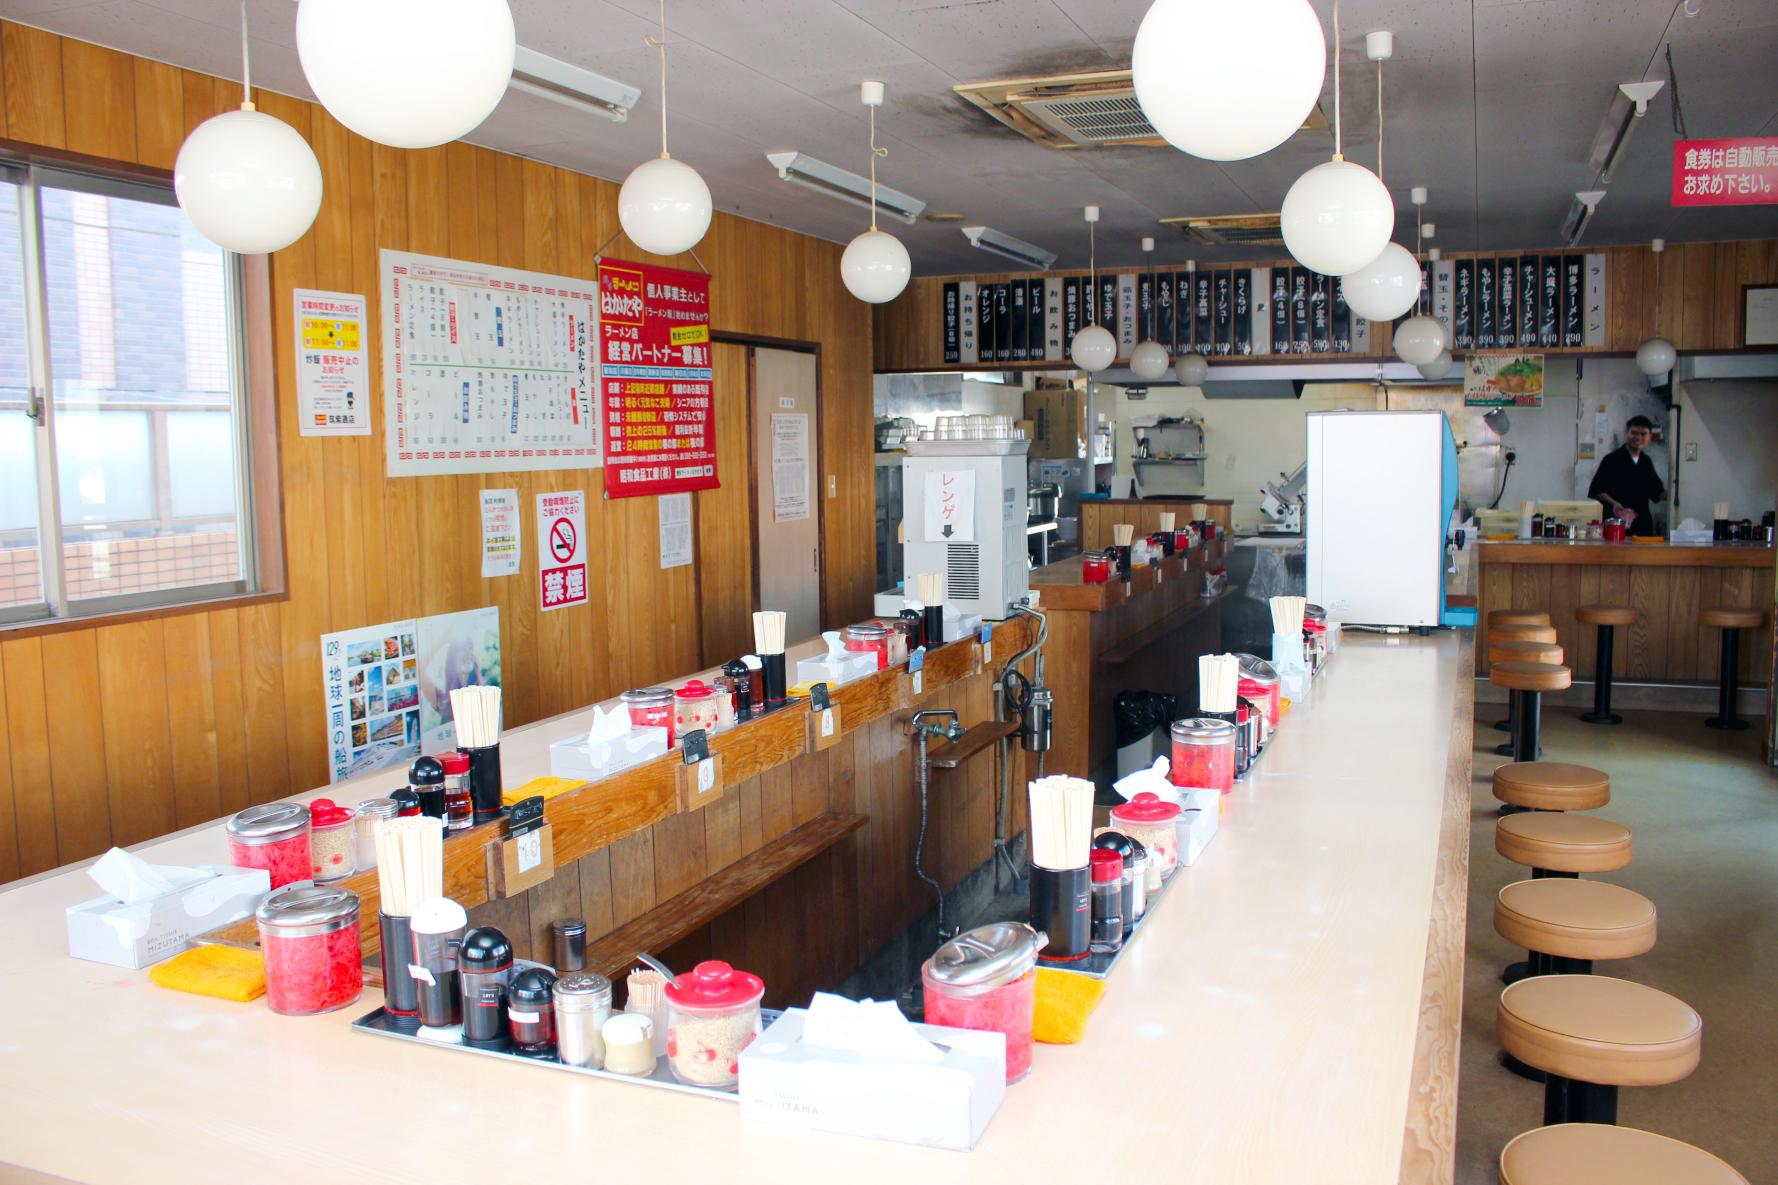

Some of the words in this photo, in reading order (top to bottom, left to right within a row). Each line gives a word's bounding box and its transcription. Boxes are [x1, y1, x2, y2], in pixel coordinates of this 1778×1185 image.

[1684, 146, 1778, 170] 食券は自動販売
[1684, 174, 1770, 195] お求め下さい。
[601, 292, 643, 317] はかたや
[647, 283, 705, 303] 個人事業主として
[999, 289, 1007, 314] コーラ
[1015, 288, 1024, 306] 清酒
[1032, 287, 1041, 314] ビール
[1104, 284, 1113, 320] ゆで玉子
[1161, 281, 1170, 307] もやし
[1180, 280, 1188, 299] ねぎ
[1199, 280, 1208, 317] 辛子高菜
[1219, 279, 1228, 324] チャーシュー
[1238, 278, 1247, 315] きくらげ
[1438, 273, 1449, 328] 替玉・その
[1460, 268, 1470, 325] ネギラーメン
[1482, 267, 1491, 328] もやしラーメン
[1525, 265, 1534, 328] チャーシューメン
[1546, 265, 1556, 327] 大盛ラーメン
[1568, 264, 1579, 327] 博多ラーメン
[1590, 268, 1600, 331] ラーメン
[964, 294, 973, 349] お持ち帰り
[982, 288, 990, 324] オレンジ
[1049, 290, 1059, 347] お飲み物
[1067, 285, 1076, 338] 焼豚おつまみ
[605, 325, 638, 339] ラーメン店
[1479, 335, 1494, 344] 390
[608, 340, 708, 364] 経営パートナー募集!
[945, 351, 958, 360] 250
[981, 350, 993, 359] 160
[997, 349, 1010, 358] 160
[1013, 348, 1026, 358] 280
[1031, 348, 1043, 357] 480
[577, 320, 589, 430] はかたやメニュー
[942, 473, 956, 520] レンゲ
[545, 567, 584, 603] 禁煙
[329, 665, 349, 782] 地球一周の船旅
[147, 932, 189, 953] MIZUTAMA
[754, 1097, 818, 1115] MIZUTAMA
